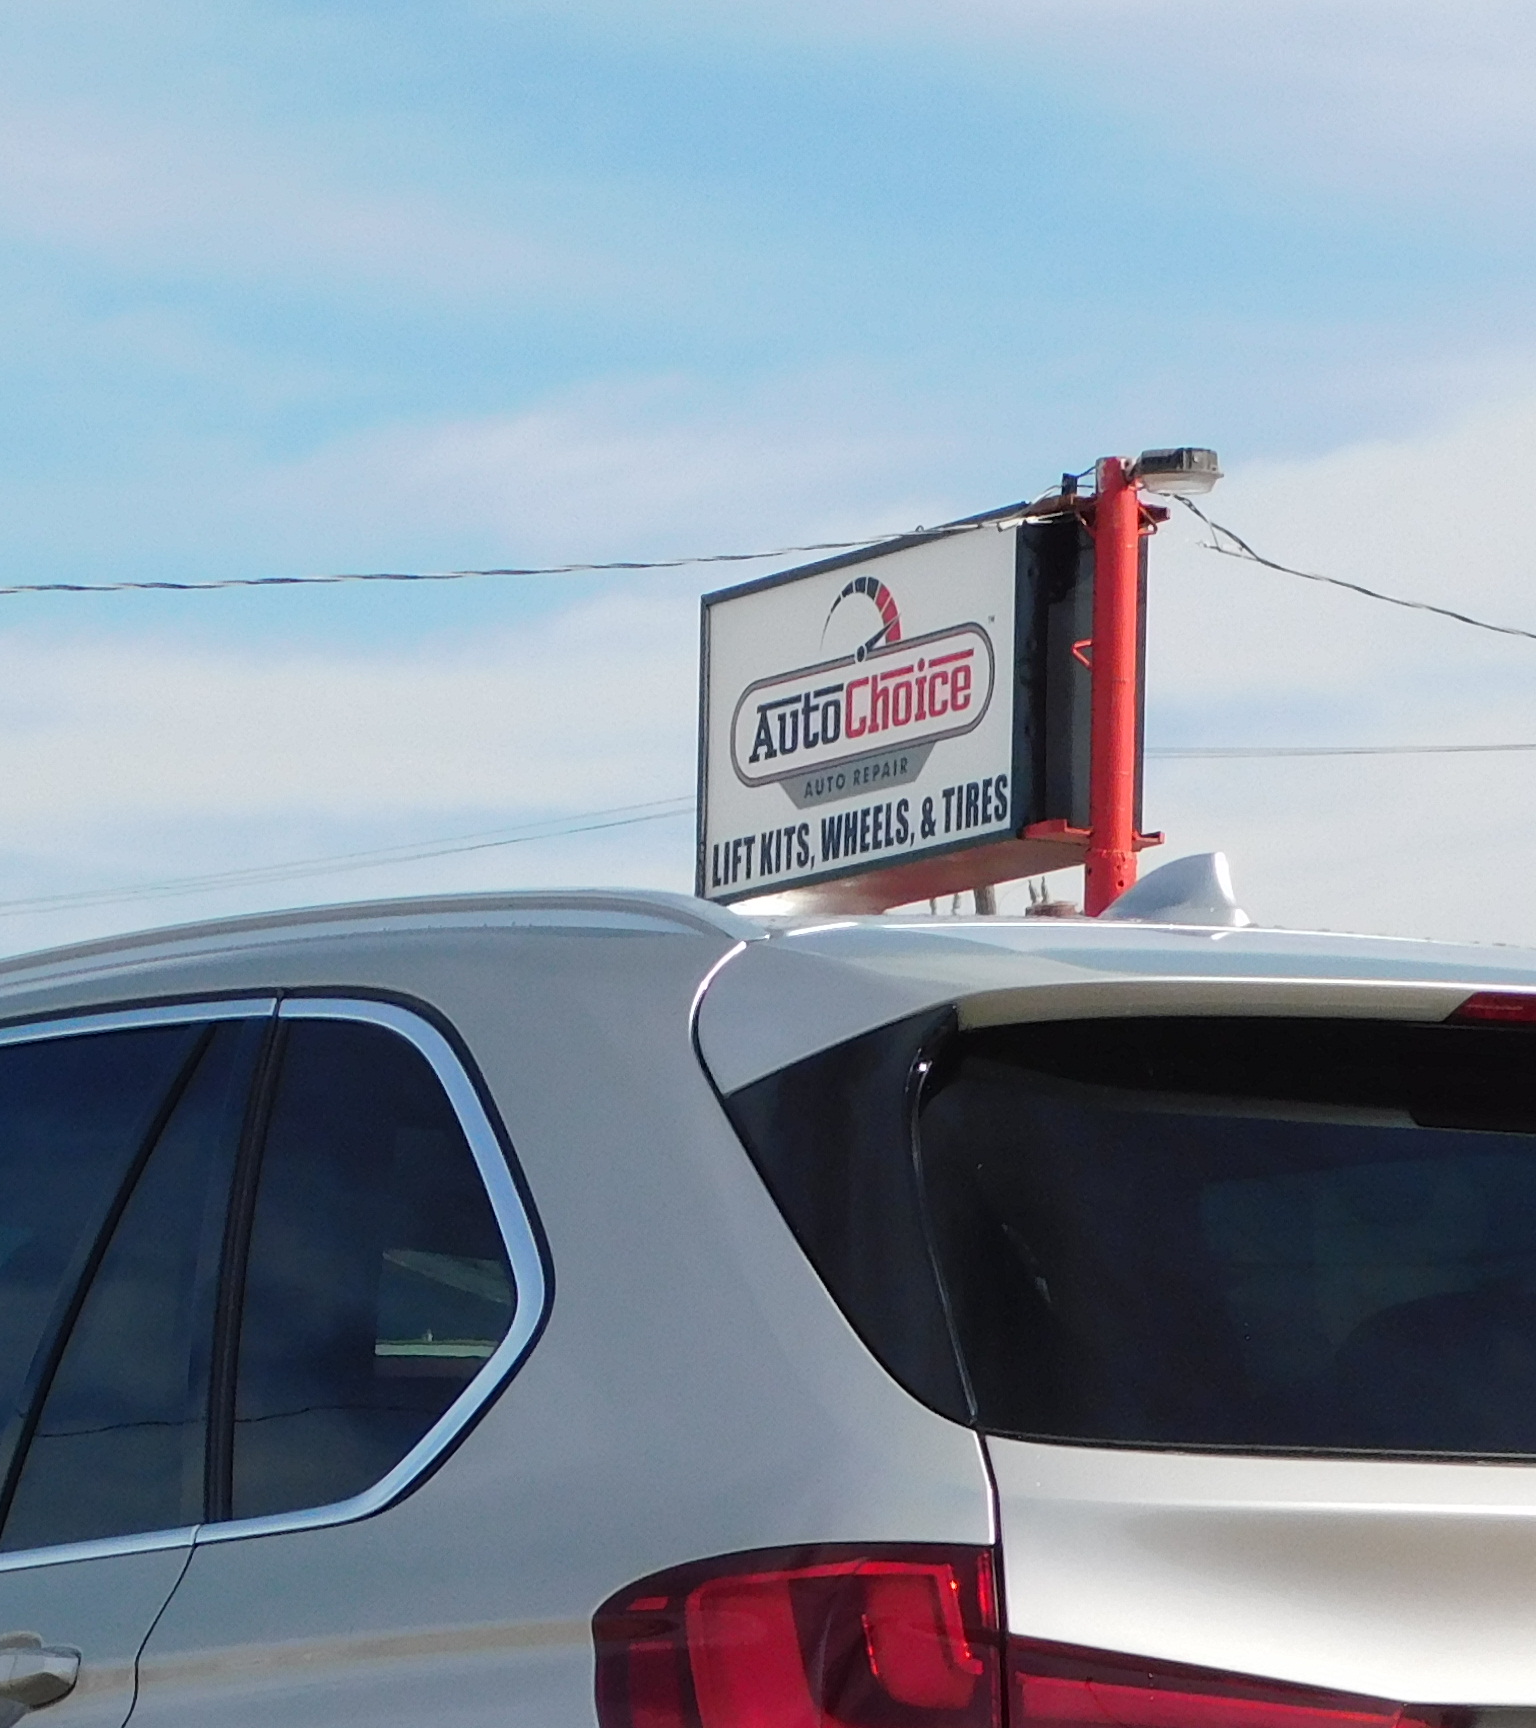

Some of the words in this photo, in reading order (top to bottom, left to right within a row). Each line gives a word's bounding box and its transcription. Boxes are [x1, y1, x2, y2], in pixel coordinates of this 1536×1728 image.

[804, 773, 846, 799] AUTO
[853, 756, 909, 787] REPAIR
[712, 835, 756, 888] LIFT
[760, 822, 816, 876] KITS,
[821, 798, 915, 862] WHEELS,
[921, 797, 936, 839] &
[942, 774, 1008, 833] TIRES
